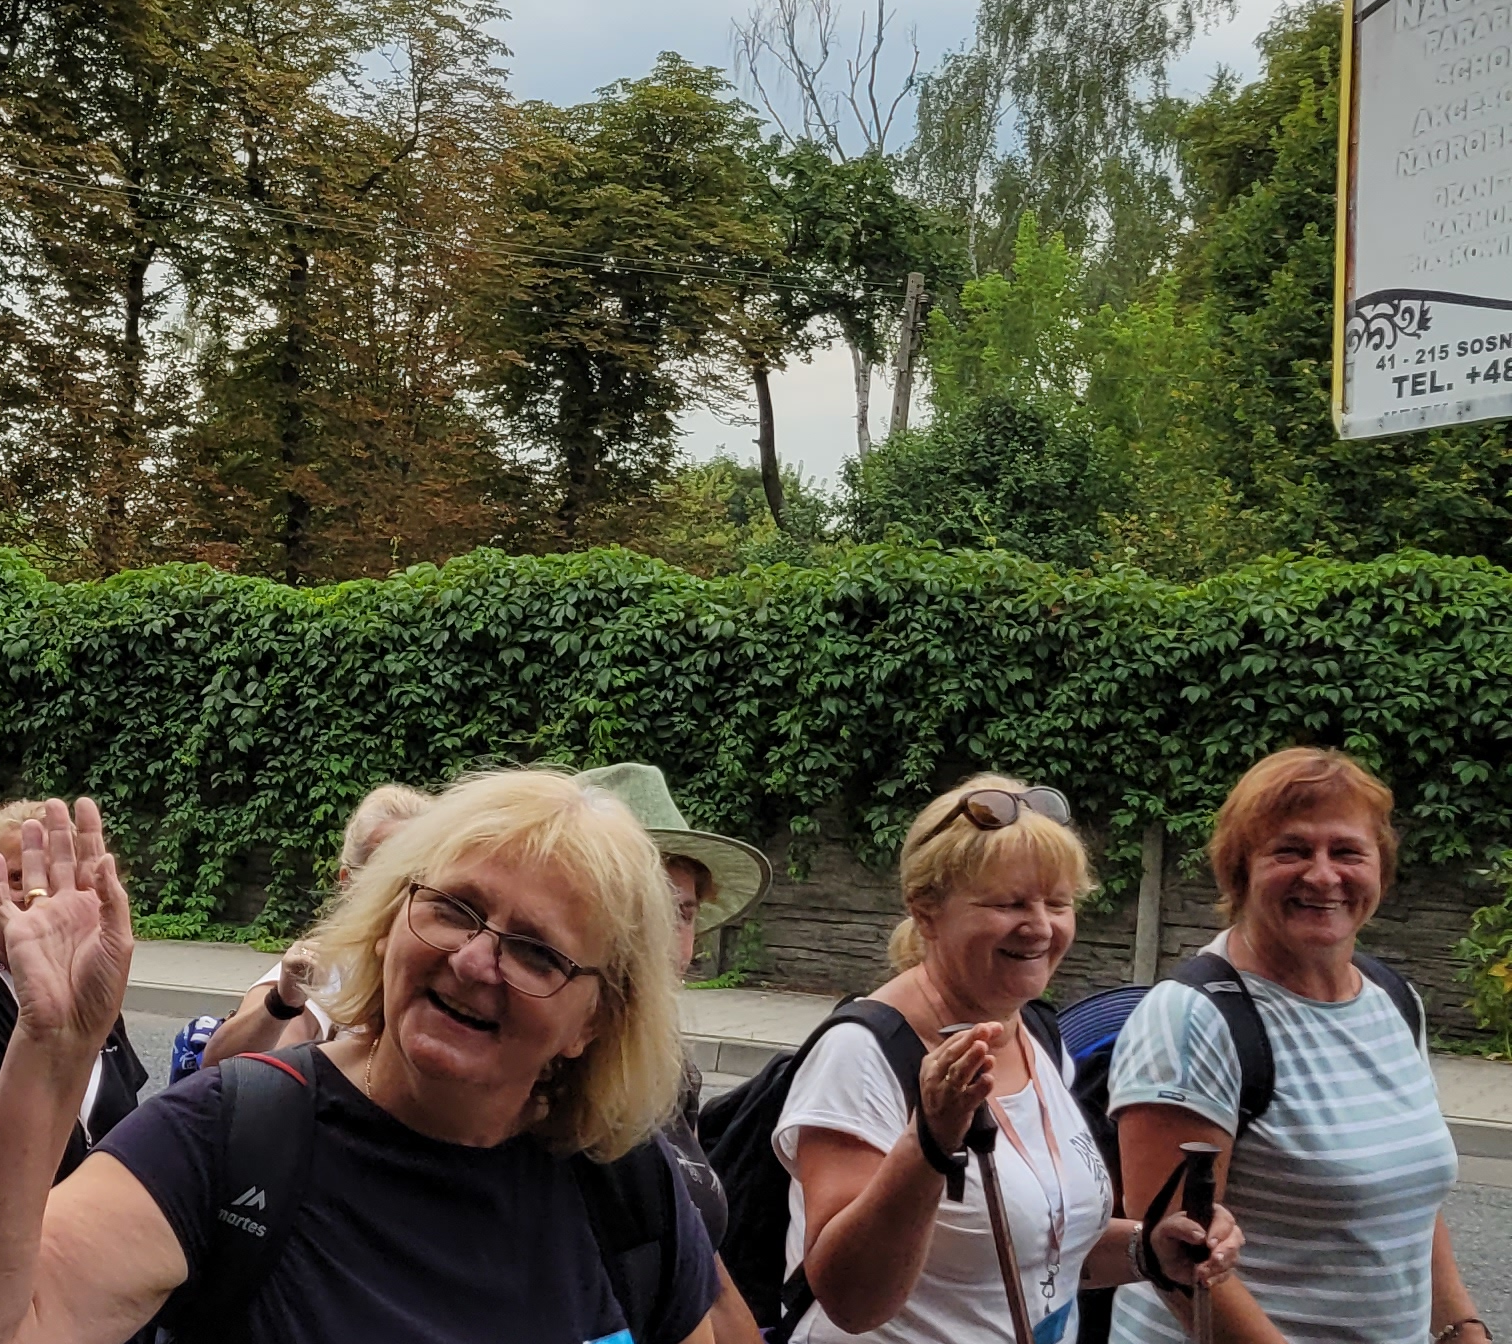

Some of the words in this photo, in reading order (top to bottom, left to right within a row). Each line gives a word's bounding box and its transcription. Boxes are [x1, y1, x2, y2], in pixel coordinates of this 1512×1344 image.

[1375, 353, 1396, 371] 41
[1414, 343, 1450, 366] 215
[1456, 333, 1512, 358] SOSN
[1392, 370, 1454, 399] TEL.
